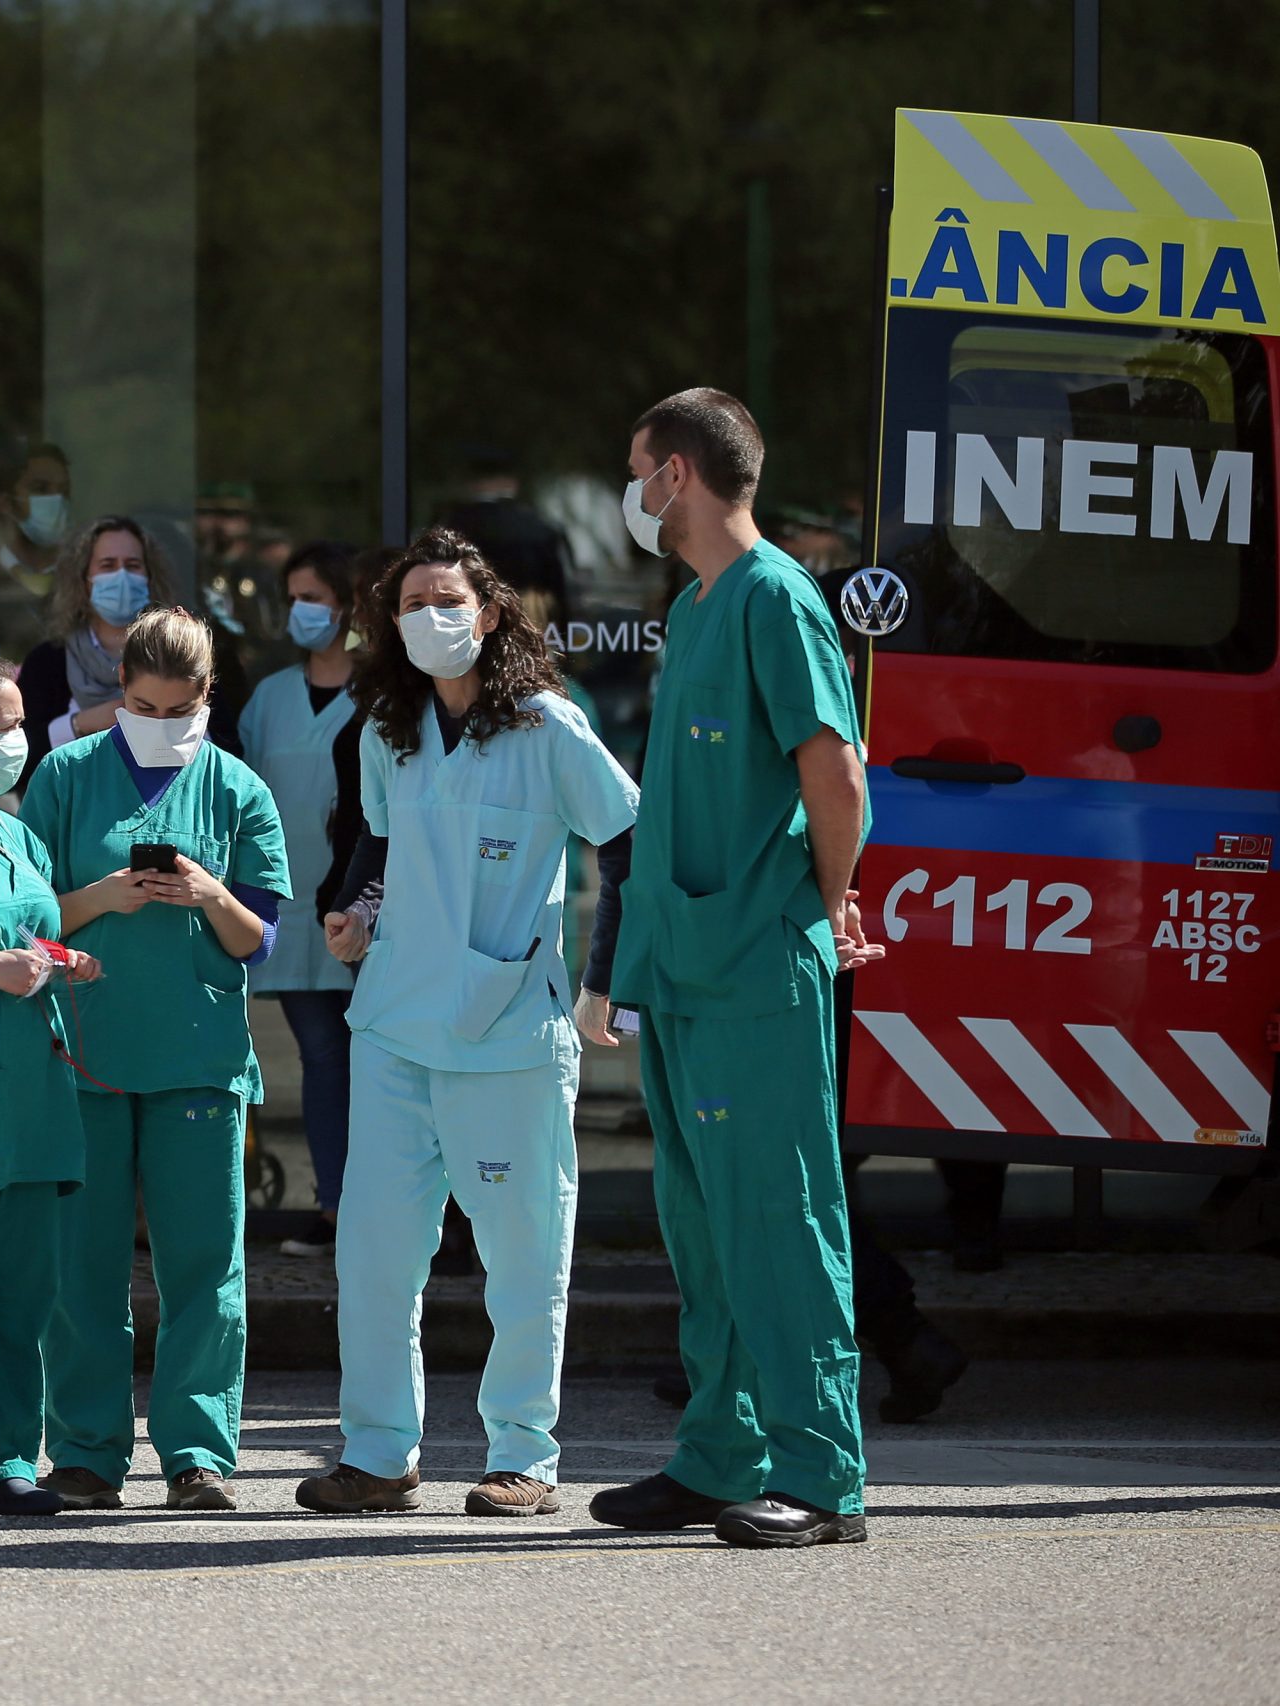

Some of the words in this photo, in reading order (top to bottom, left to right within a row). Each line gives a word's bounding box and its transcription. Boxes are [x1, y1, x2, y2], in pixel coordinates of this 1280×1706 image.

[904, 430, 1254, 545] INEM
[1219, 835, 1272, 855] TDI
[933, 875, 1093, 955] 112
[1162, 888, 1255, 921] 1127
[1151, 920, 1261, 953] ABSC
[1183, 952, 1228, 982] 12
